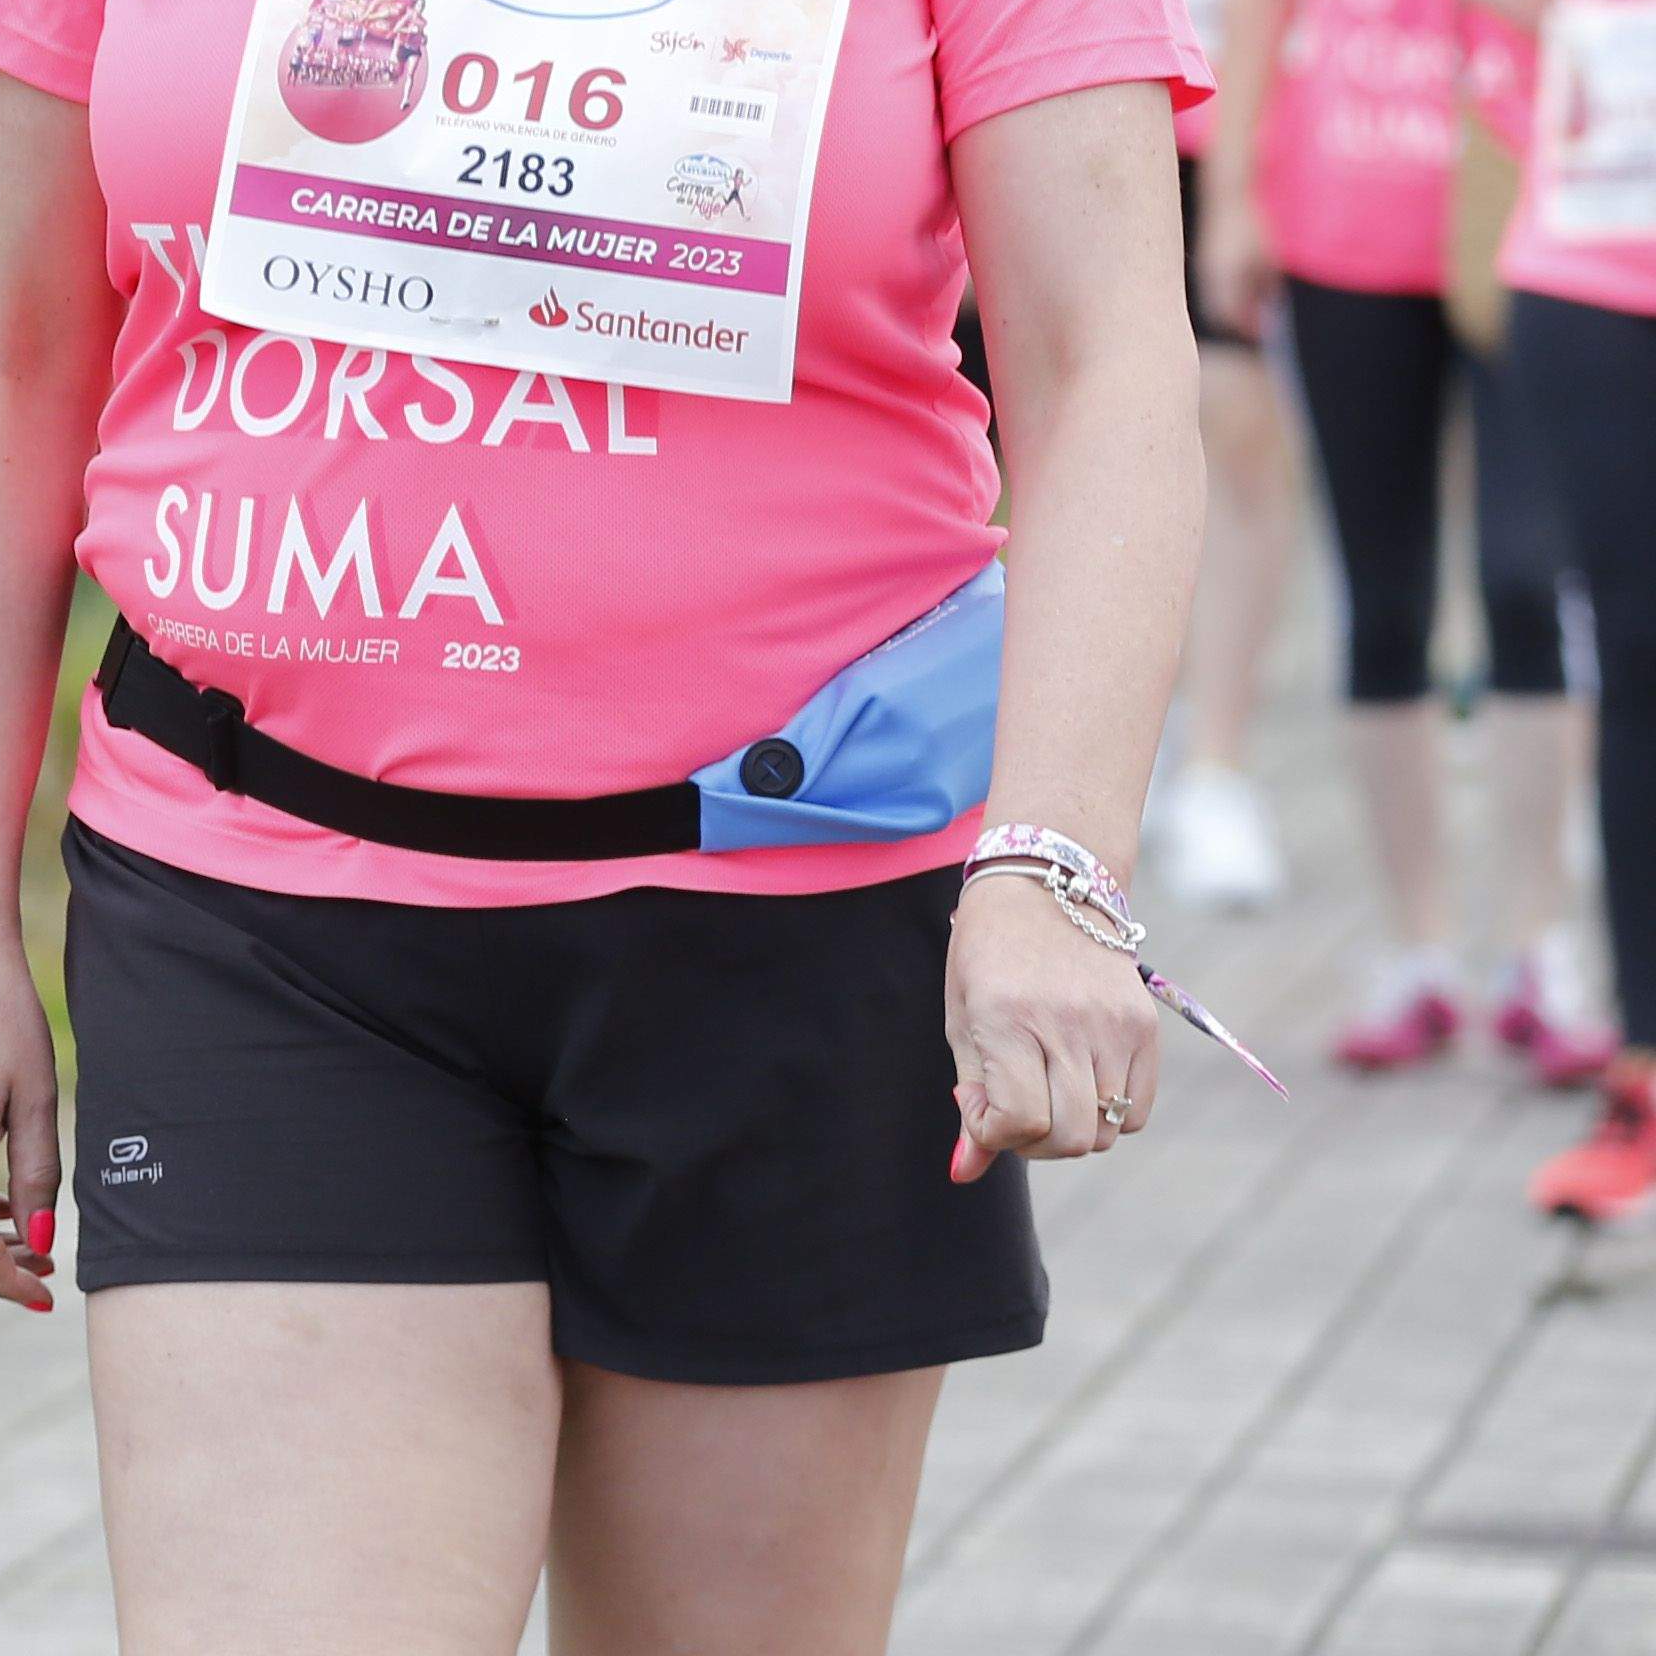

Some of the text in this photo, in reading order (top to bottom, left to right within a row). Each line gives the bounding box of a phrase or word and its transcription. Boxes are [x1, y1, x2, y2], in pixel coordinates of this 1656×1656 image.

[442, 51, 627, 131] 016
[494, 121, 550, 138] VIOLENCIA
[553, 128, 567, 140] DE
[457, 145, 575, 197] 2183
[290, 188, 744, 277] CARRERA DE LA MUJER 2023
[262, 254, 749, 355] OYSHO Santander
[173, 329, 658, 456] DORSAL
[144, 484, 504, 626] SUMA
[147, 611, 521, 673] CARRERA DE LA MUJER 2023
